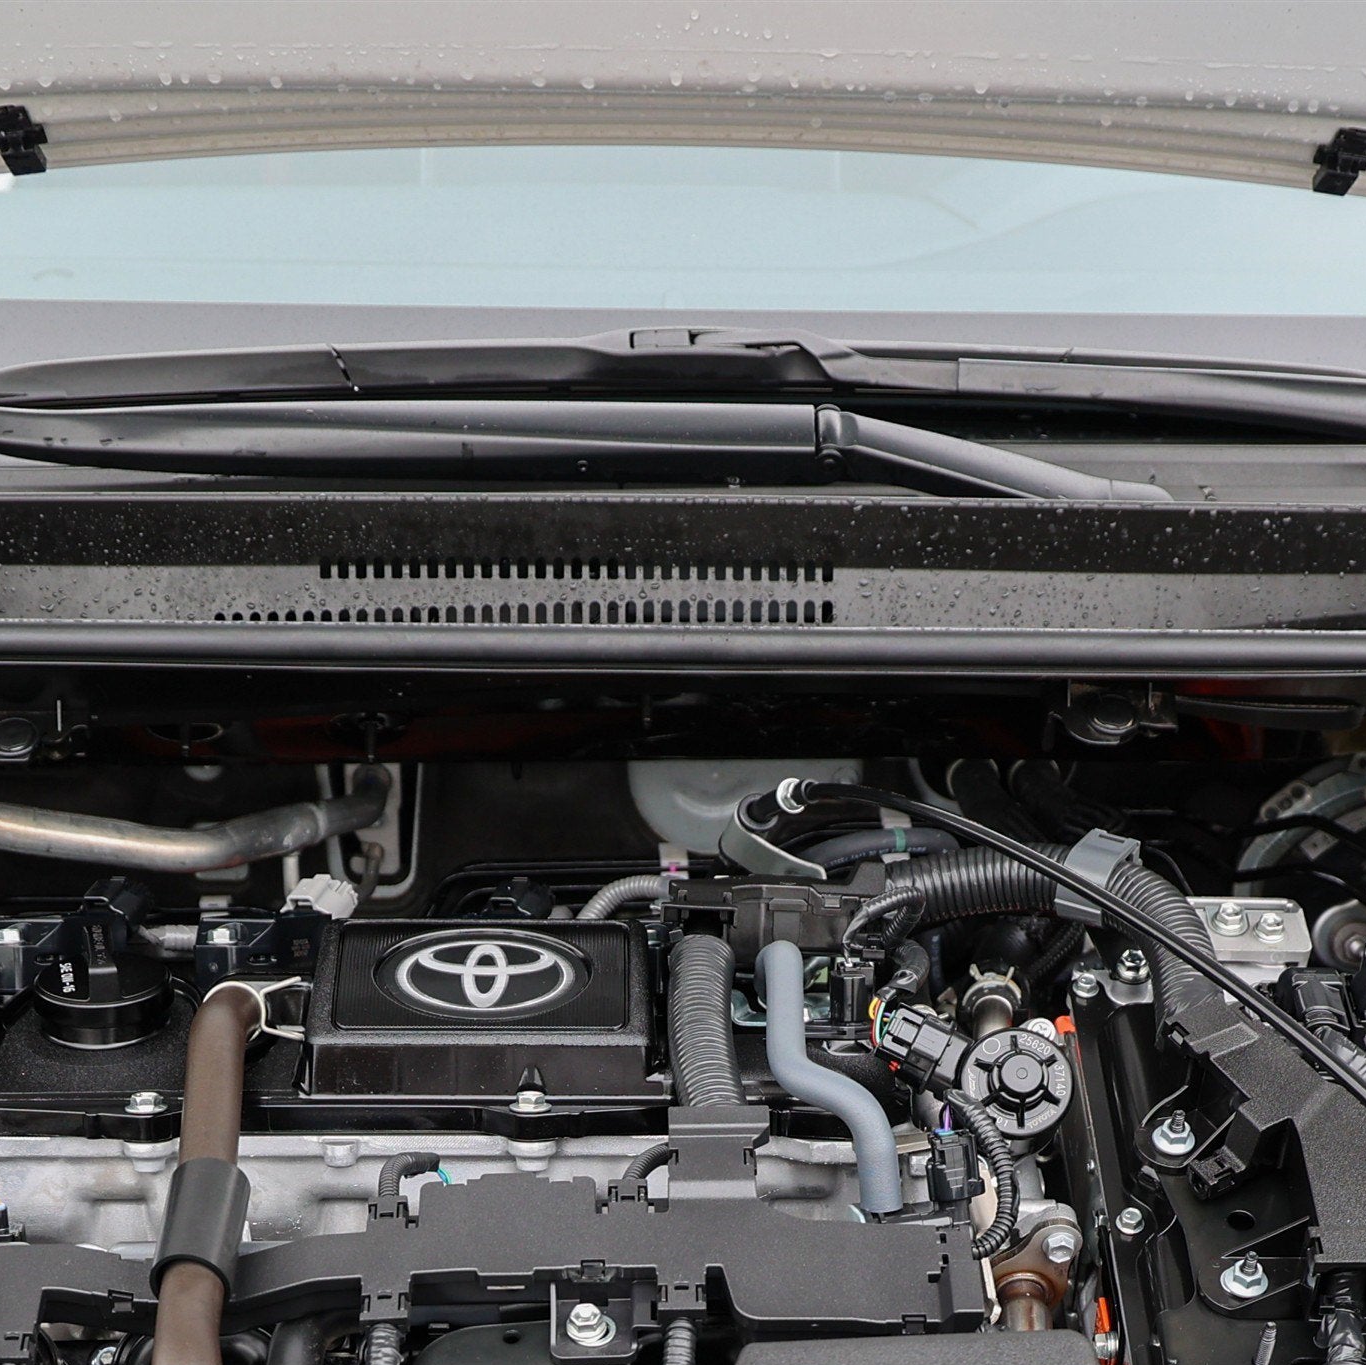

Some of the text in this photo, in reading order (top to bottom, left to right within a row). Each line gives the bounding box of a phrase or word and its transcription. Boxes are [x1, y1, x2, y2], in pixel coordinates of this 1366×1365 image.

[1017, 1033, 1052, 1056] 25620
[1053, 1064, 1067, 1097] 37140
[1026, 1106, 1059, 1130] TOYOTA
